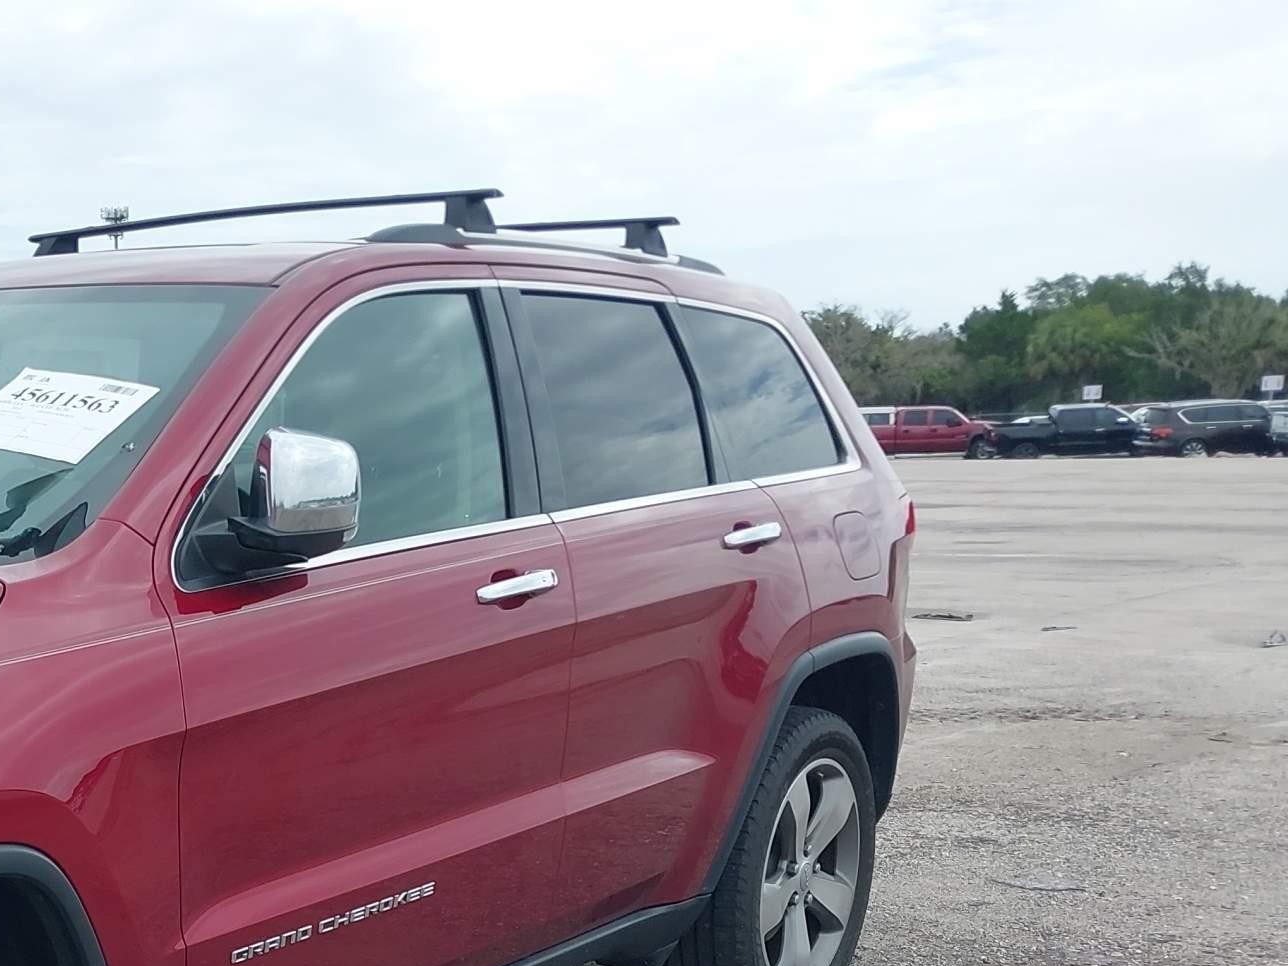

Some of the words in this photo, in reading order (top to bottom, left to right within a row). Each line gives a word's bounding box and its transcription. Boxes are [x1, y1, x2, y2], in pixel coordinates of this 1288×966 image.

[11, 386, 120, 414] 45611563
[230, 924, 313, 965] GRAND
[318, 881, 436, 934] CHEROKEE
